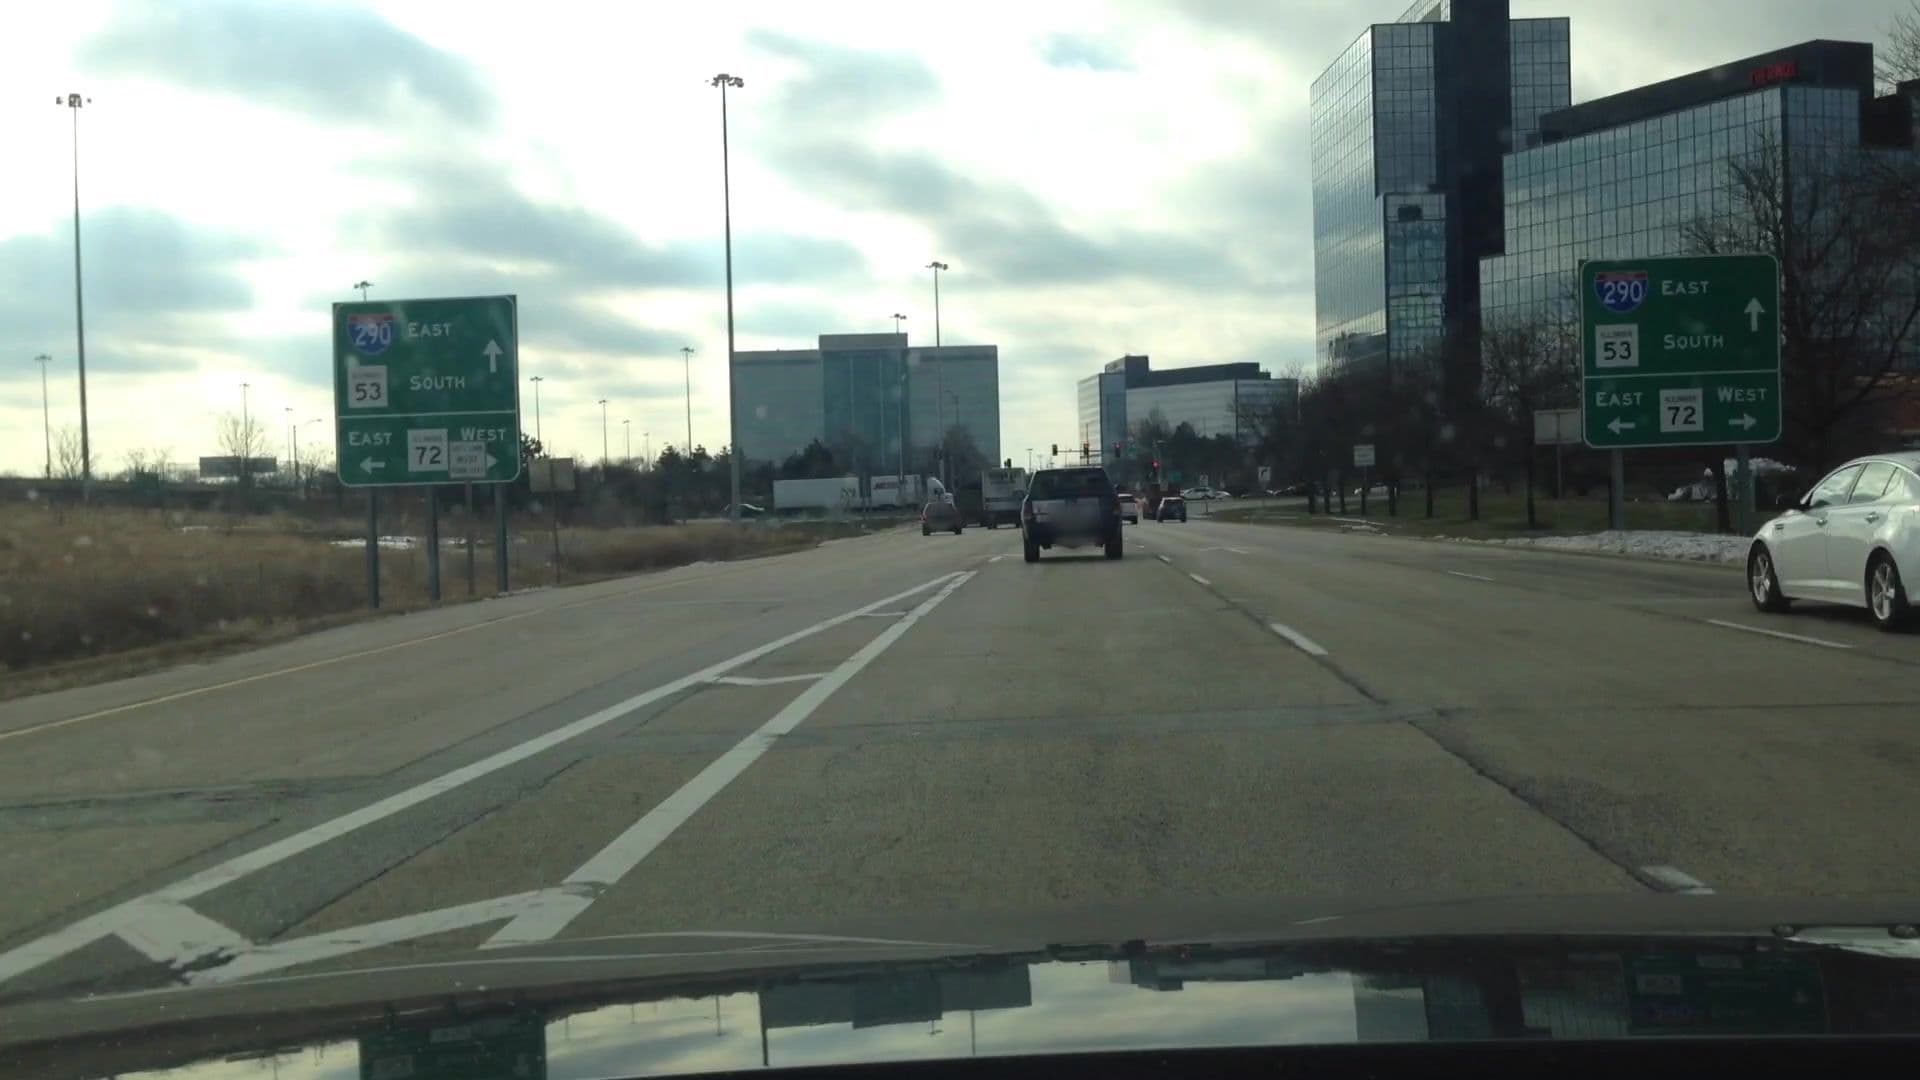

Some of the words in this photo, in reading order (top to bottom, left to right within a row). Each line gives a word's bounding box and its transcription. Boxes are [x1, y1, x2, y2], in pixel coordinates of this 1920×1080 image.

[1603, 281, 1643, 305] 290
[1661, 280, 1710, 295] EAST
[354, 322, 392, 347] 290
[407, 322, 452, 338] EAST
[1663, 333, 1724, 350] SOUTH
[1603, 341, 1632, 361] 53
[409, 375, 466, 391] SOUTH
[355, 382, 382, 402] 53
[1595, 391, 1644, 407] EAST
[1717, 386, 1768, 403] WEST
[1667, 406, 1697, 426] 72
[348, 431, 393, 446] EAST
[460, 426, 507, 442] WEST
[415, 446, 442, 465] 72
